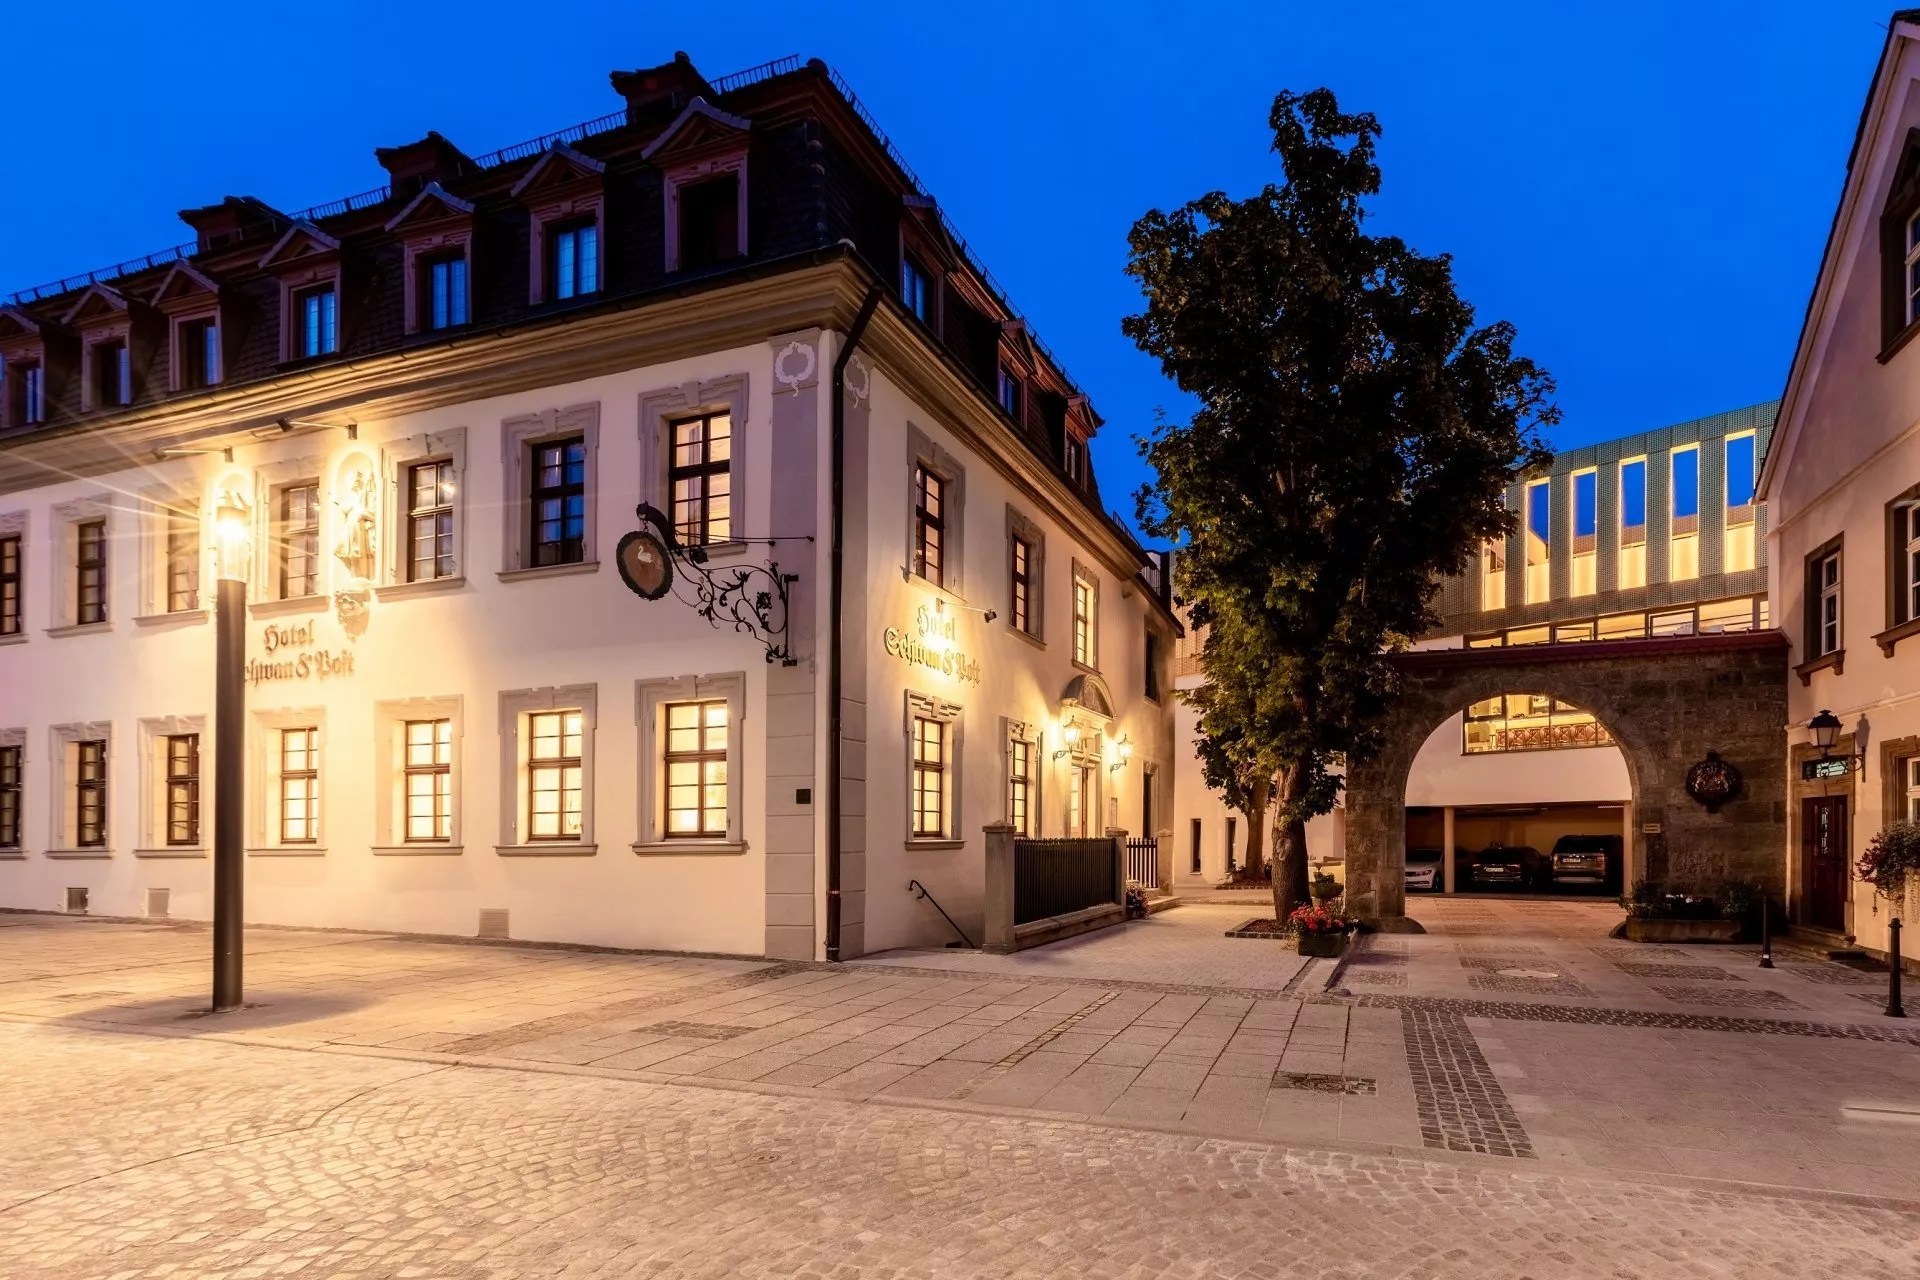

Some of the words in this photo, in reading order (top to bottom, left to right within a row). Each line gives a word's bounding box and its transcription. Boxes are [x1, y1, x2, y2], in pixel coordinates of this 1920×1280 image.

[264, 619, 315, 655] Hotel
[296, 652, 313, 679] &
[314, 649, 355, 684] Post
[883, 626, 941, 671] Schwan
[942, 648, 955, 676] &
[956, 651, 981, 688] Post
